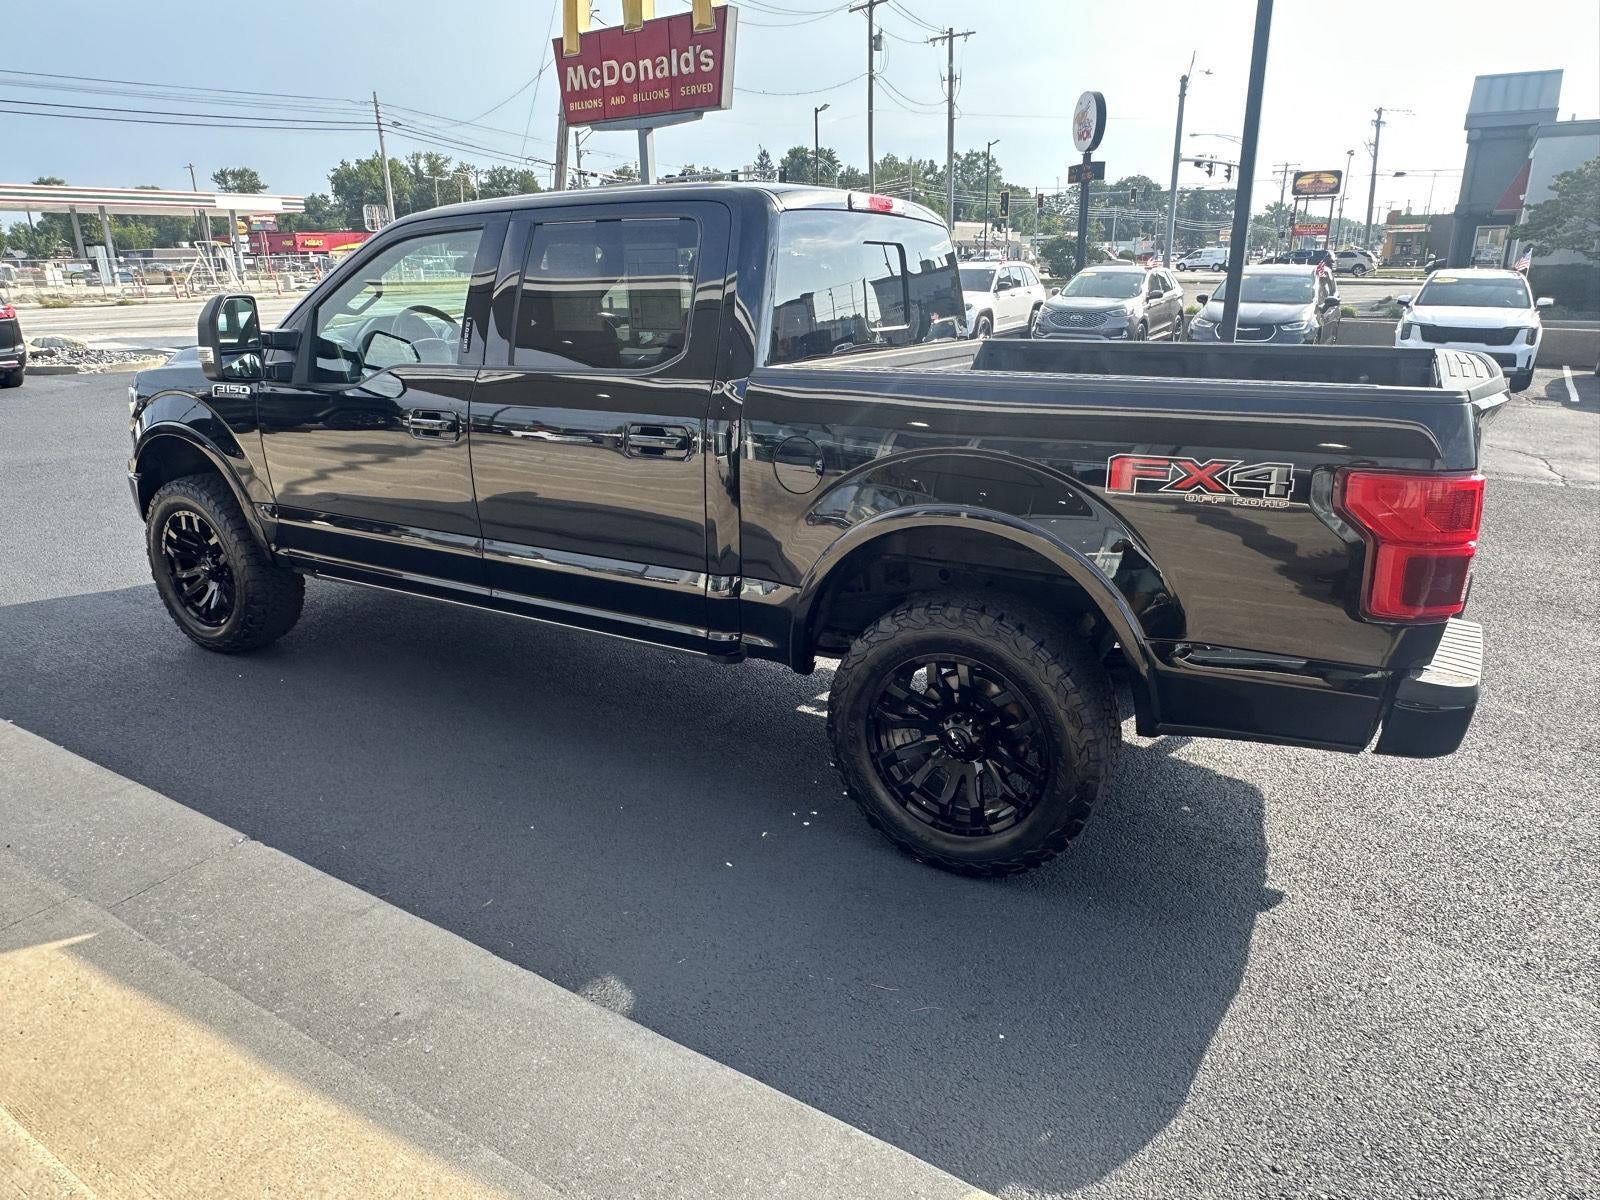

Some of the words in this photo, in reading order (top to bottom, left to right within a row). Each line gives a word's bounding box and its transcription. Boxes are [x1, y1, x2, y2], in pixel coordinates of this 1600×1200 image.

[566, 45, 715, 92] McDonald's
[569, 98, 604, 111] BILLIONS
[610, 95, 626, 106] AND
[632, 88, 670, 103] BILLIONS
[680, 82, 714, 96] SERVED
[1105, 453, 1296, 501] FX4
[1184, 493, 1226, 503] OFF
[1232, 497, 1290, 508] ROAD
